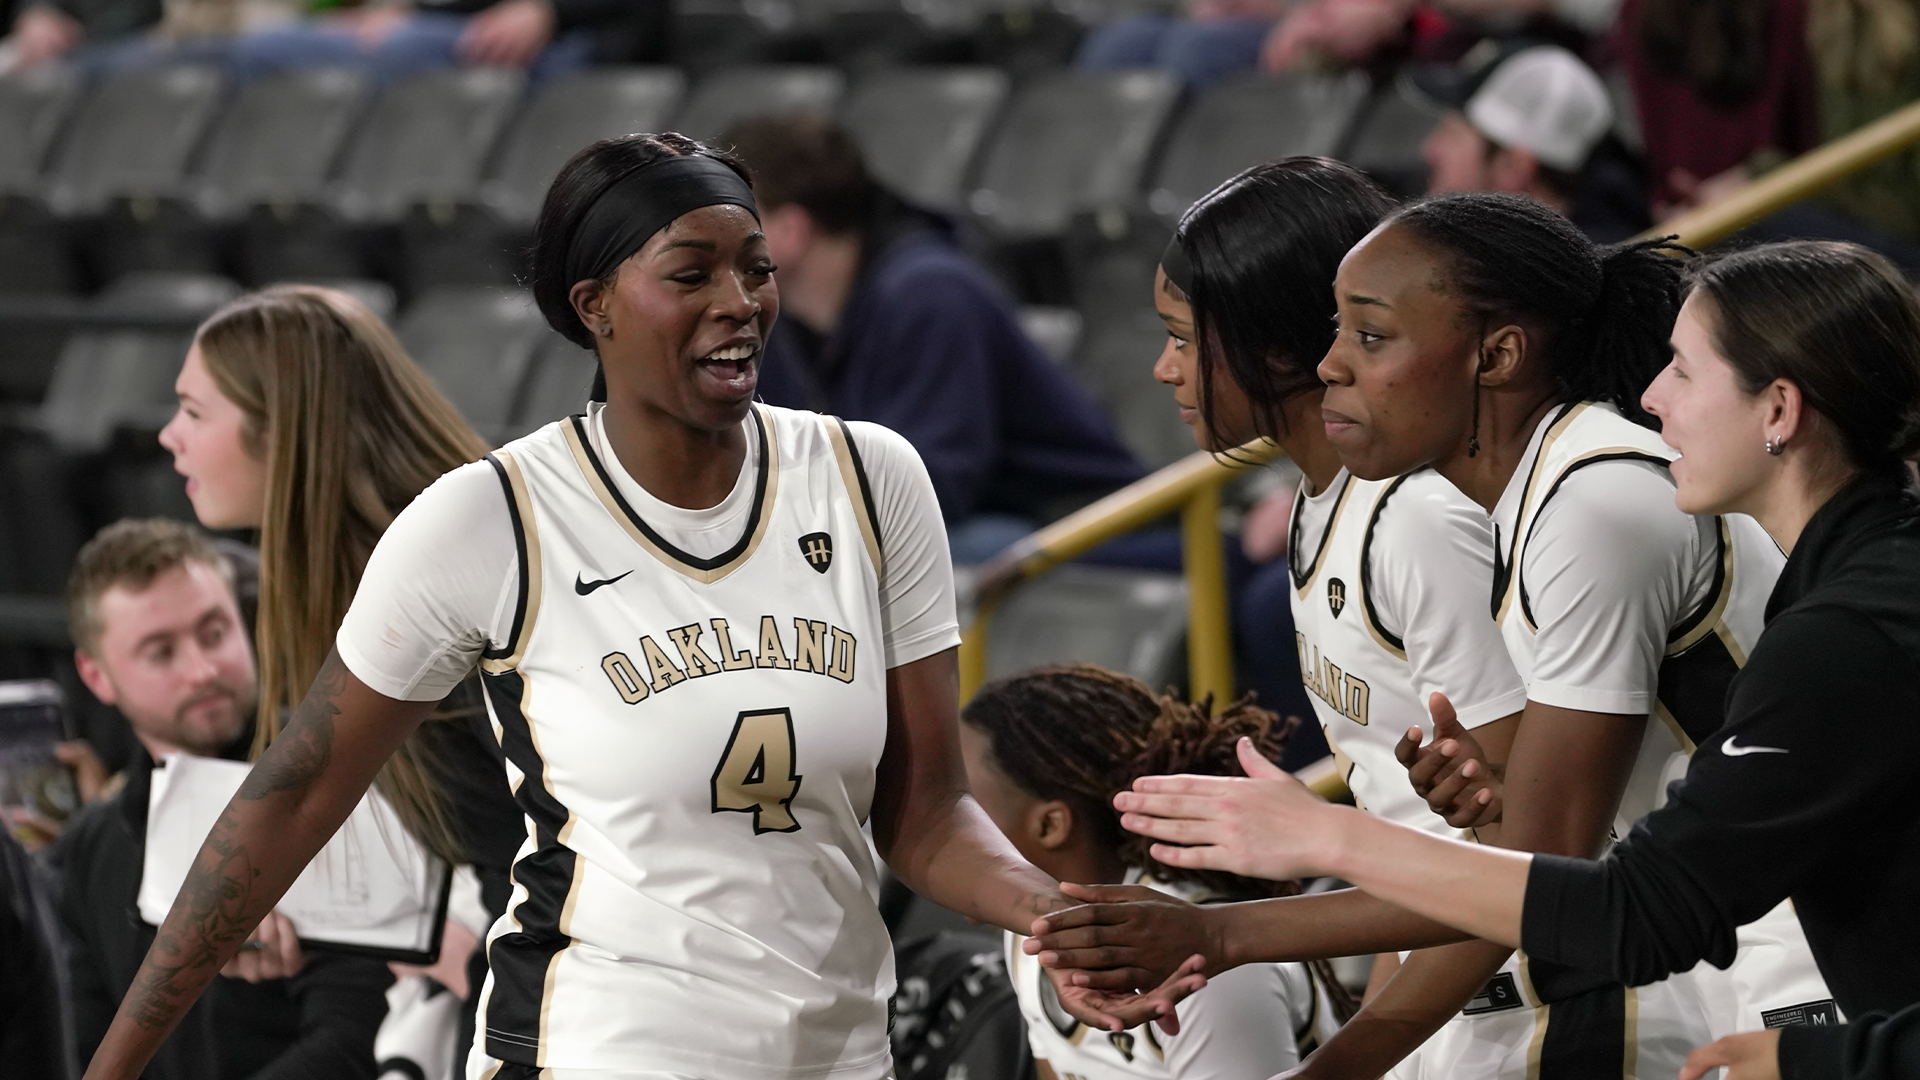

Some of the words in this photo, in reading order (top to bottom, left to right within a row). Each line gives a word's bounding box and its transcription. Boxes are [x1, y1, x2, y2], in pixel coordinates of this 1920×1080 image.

[600, 616, 856, 705] OAKLAND
[1295, 630, 1370, 727] LAND
[710, 707, 802, 835] 4
[1496, 986, 1506, 998] S
[1766, 1010, 1802, 1021] ENGINEERED
[1813, 1012, 1827, 1026] M
